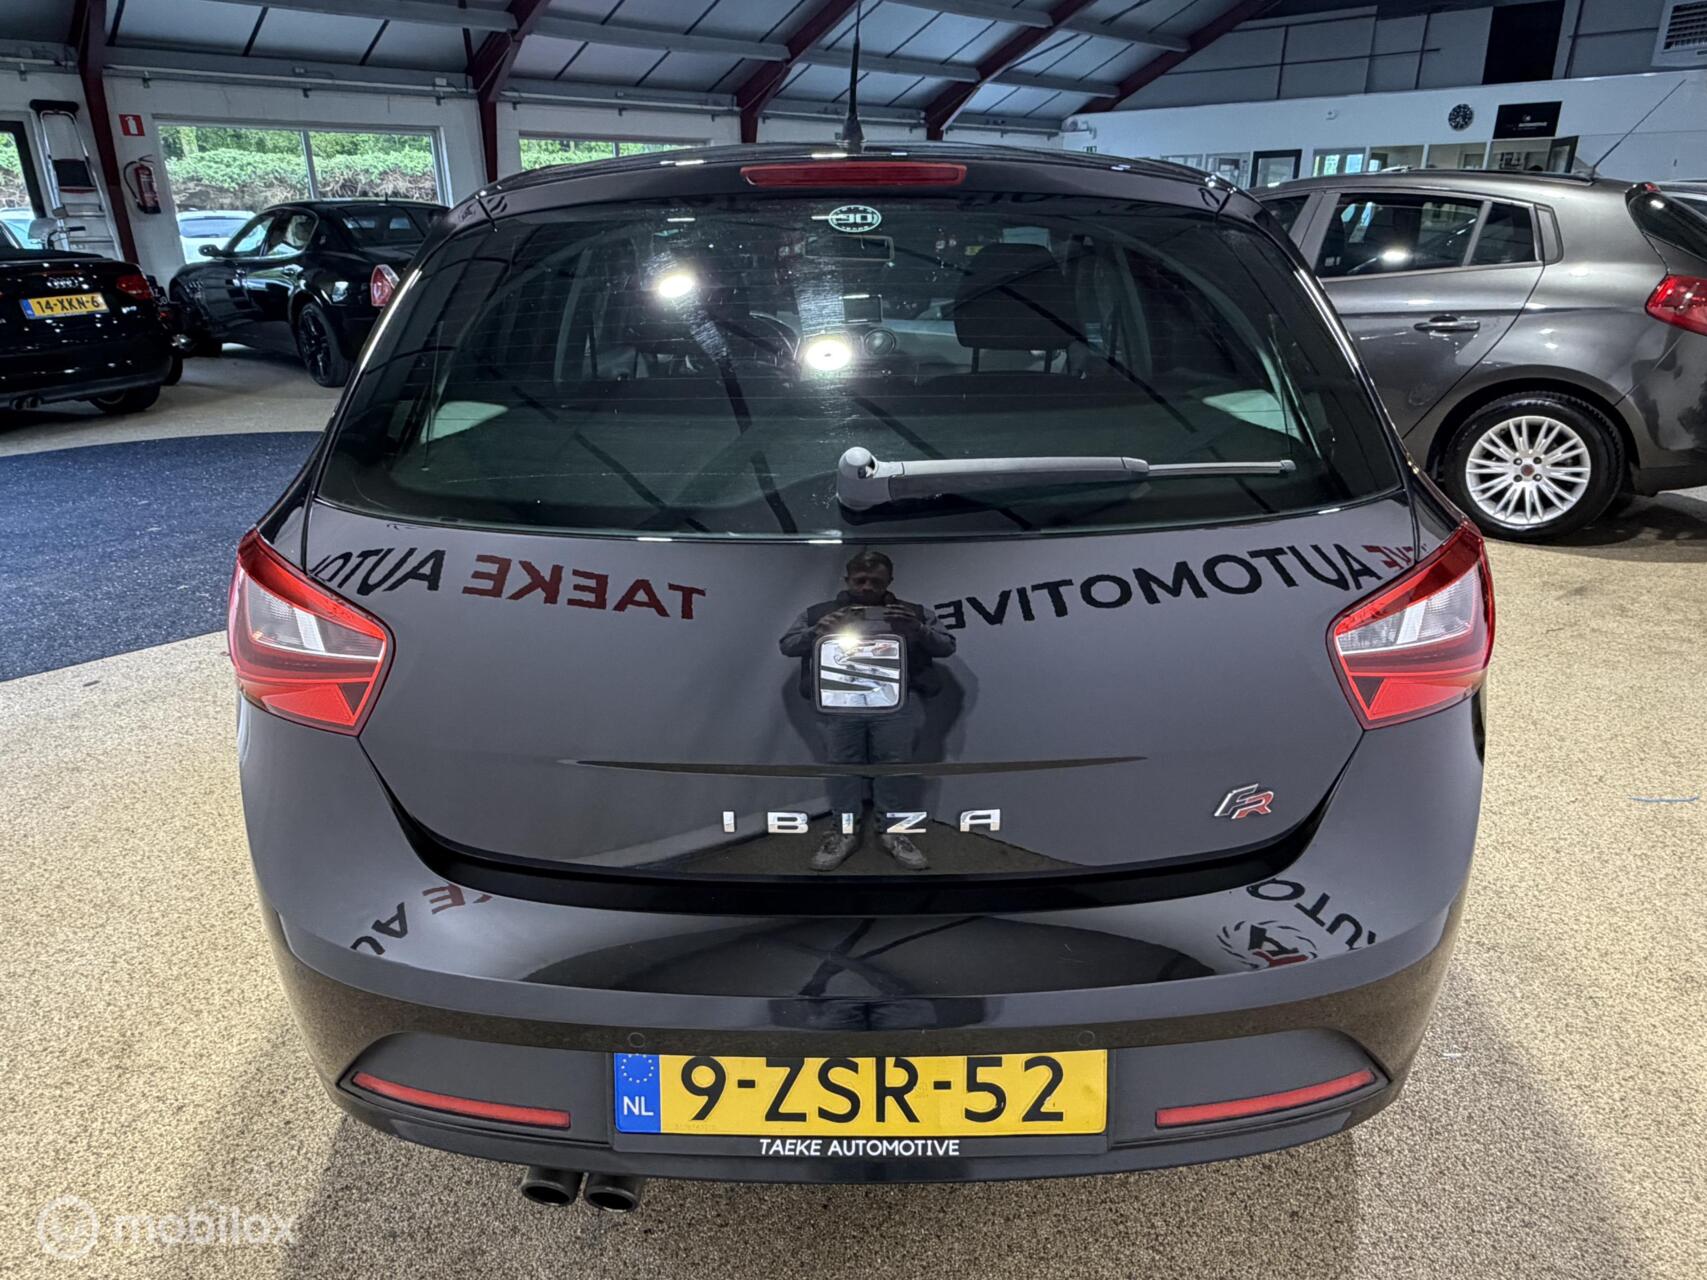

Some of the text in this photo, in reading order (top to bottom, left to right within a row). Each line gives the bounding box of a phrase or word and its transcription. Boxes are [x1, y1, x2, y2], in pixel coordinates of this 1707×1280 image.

[1214, 783, 1274, 819] FR
[722, 808, 1001, 834] IBIZA
[681, 1056, 1064, 1123] 9-ZSR-52
[623, 1096, 654, 1116] NL
[760, 1139, 960, 1156] TAEKE AUTOMOTIVE
